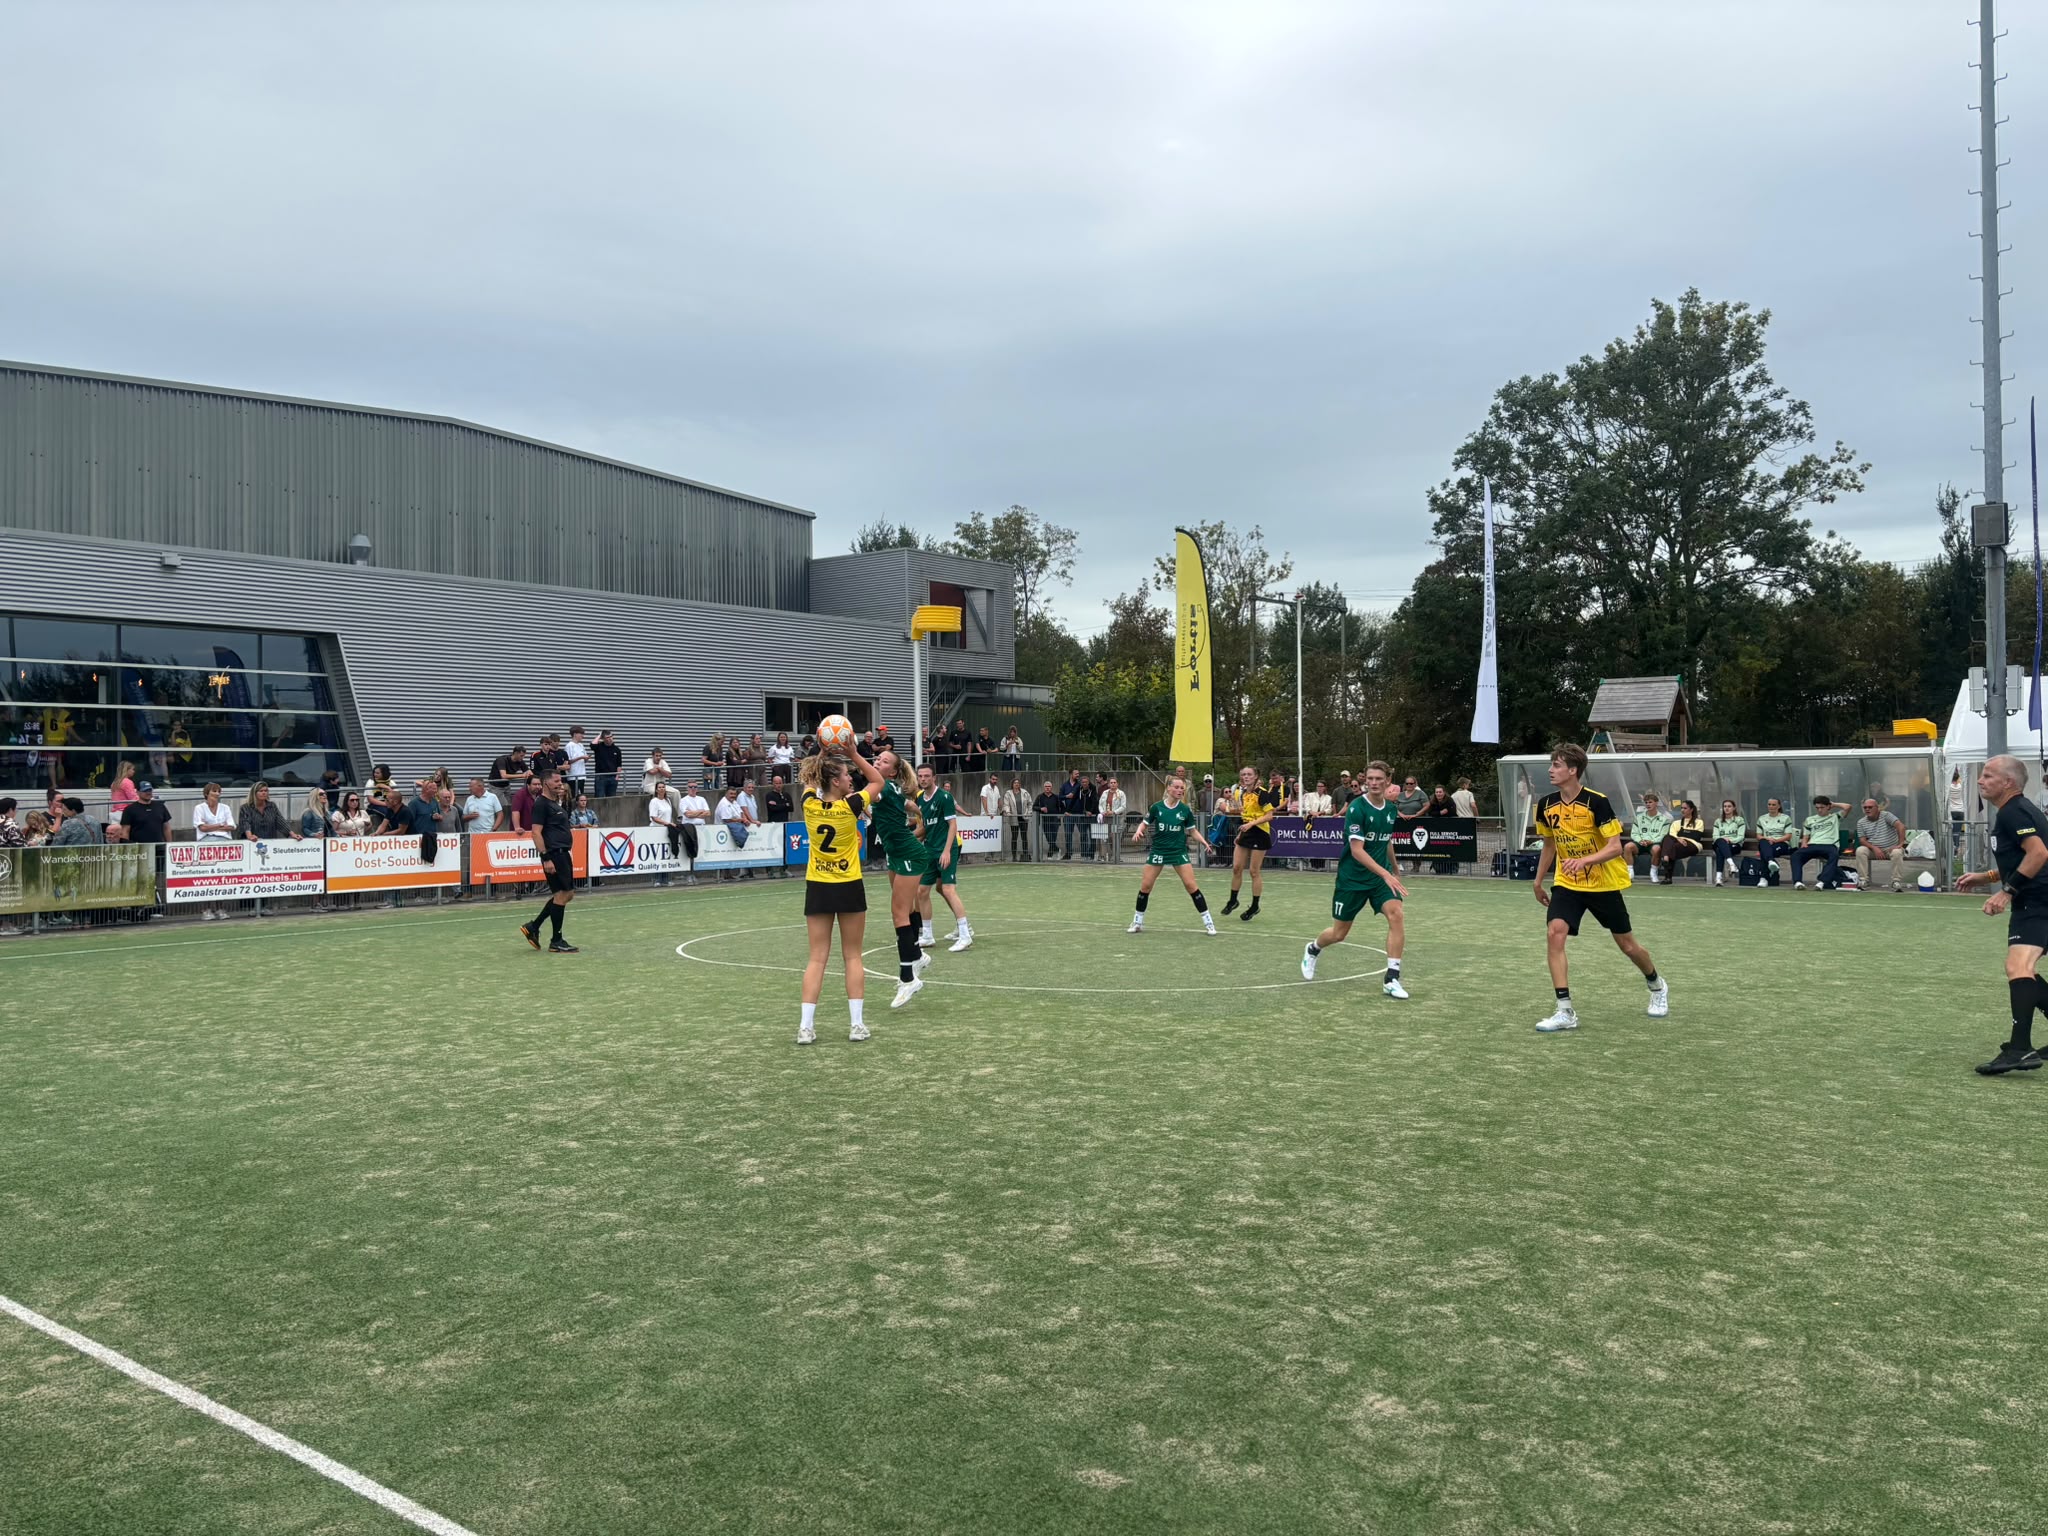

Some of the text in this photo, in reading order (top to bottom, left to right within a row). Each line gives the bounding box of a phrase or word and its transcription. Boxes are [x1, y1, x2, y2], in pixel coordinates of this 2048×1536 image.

[1547, 813, 1560, 830] 12
[816, 823, 837, 853] 2
[1277, 829, 1343, 839] PMC IN BALAN
[272, 846, 321, 854] Sleutelservice
[329, 839, 348, 853] De
[40, 852, 148, 864] Wandelcoach Zeeland
[170, 845, 243, 862] VAN KEMPEN
[637, 863, 660, 871] Quality
[192, 872, 302, 886] www.fun-onwheels.nl
[173, 883, 318, 898] Kanaalstraat 72 Oost-Souburg
[1334, 901, 1344, 916] 17
